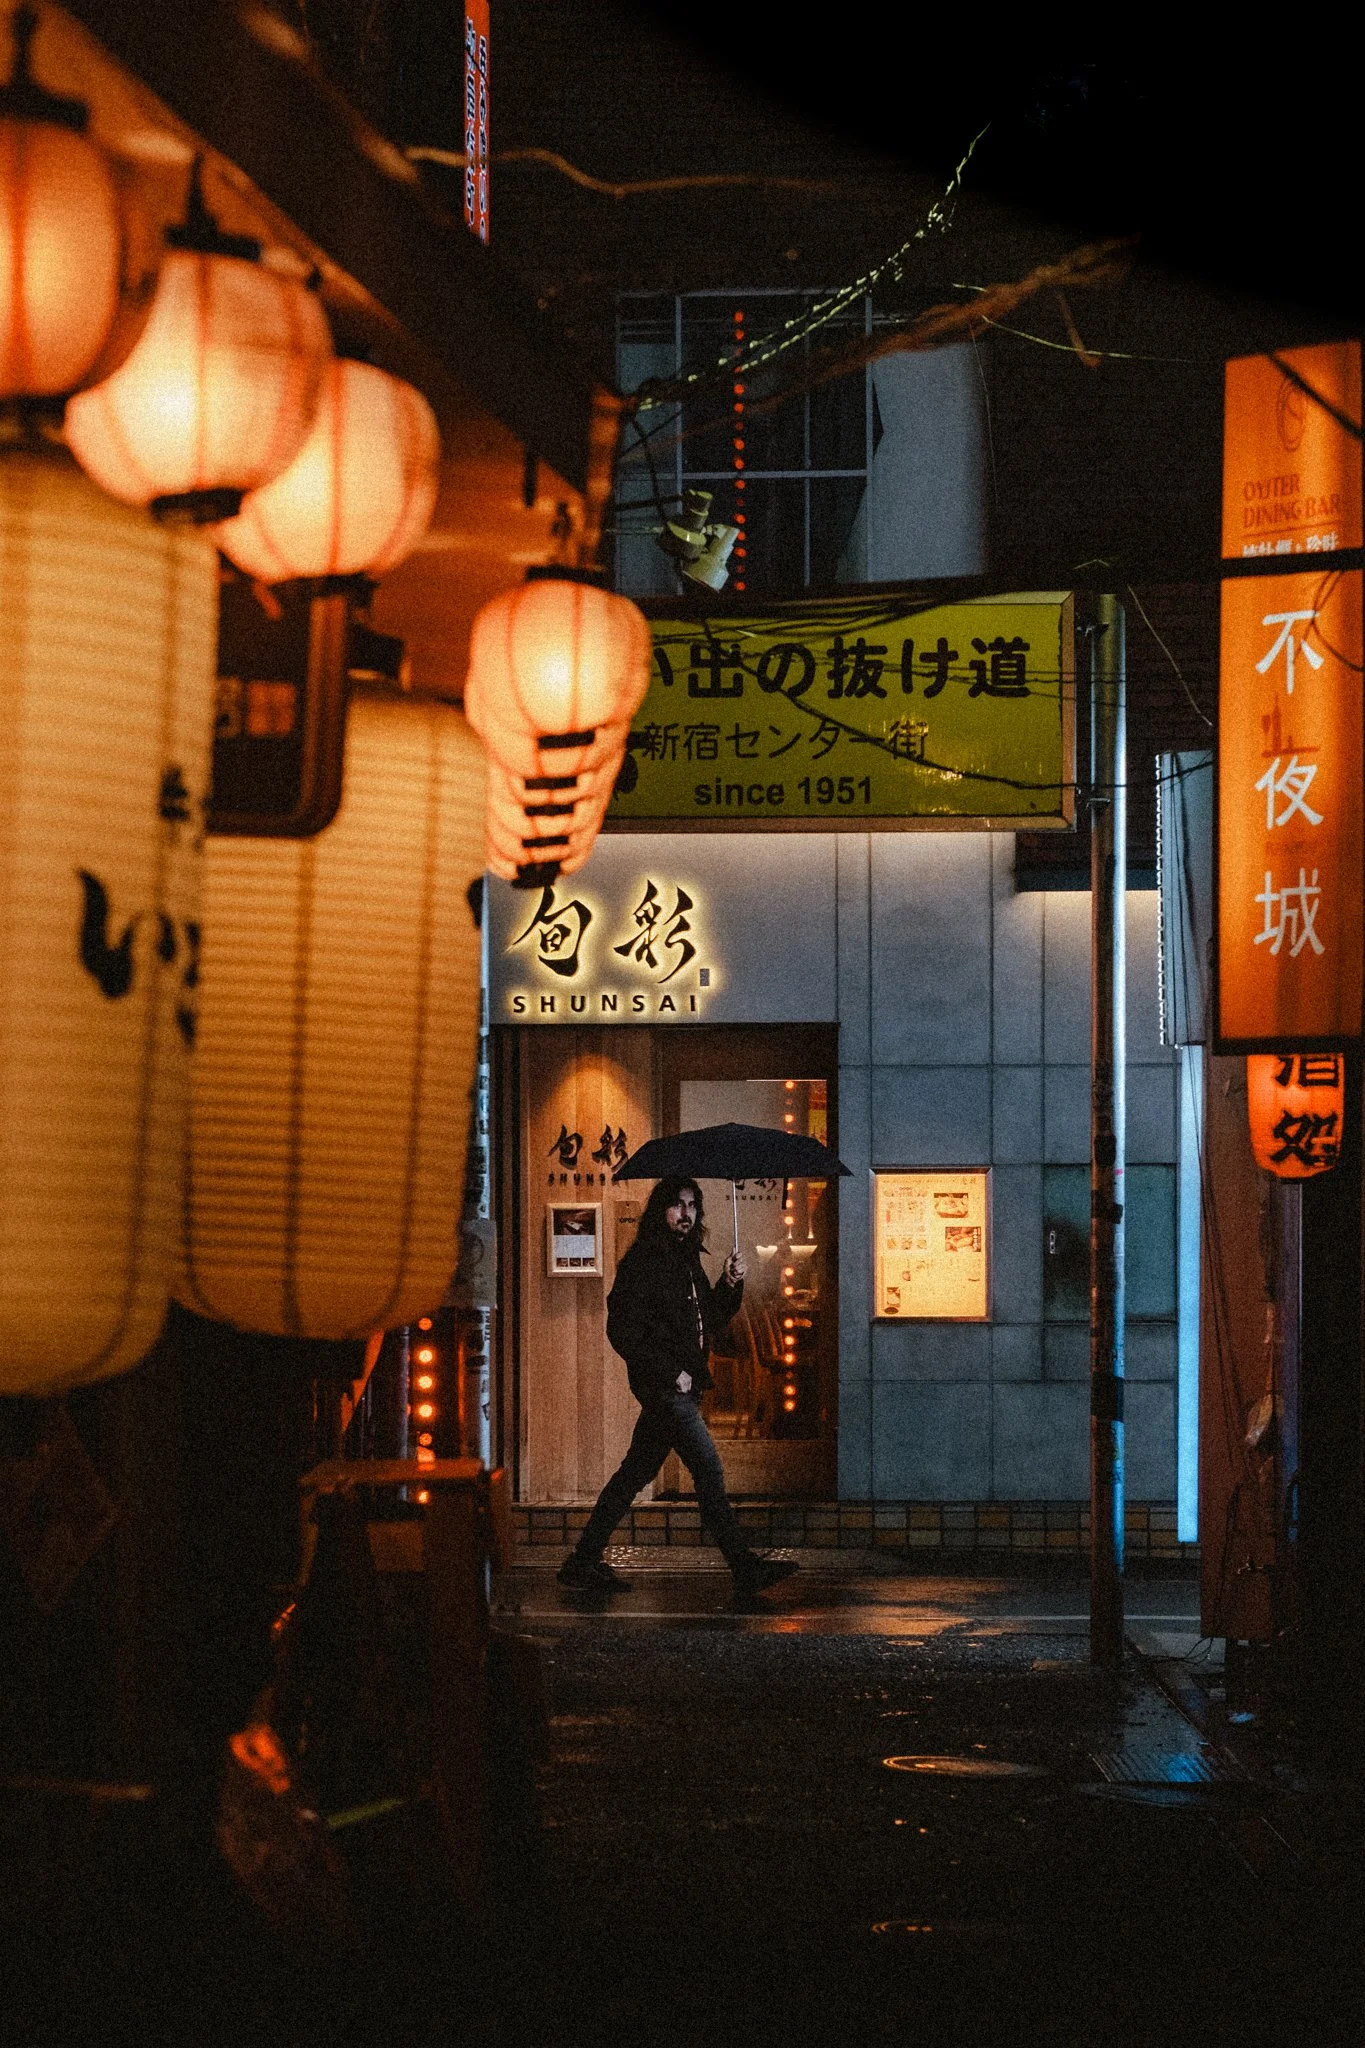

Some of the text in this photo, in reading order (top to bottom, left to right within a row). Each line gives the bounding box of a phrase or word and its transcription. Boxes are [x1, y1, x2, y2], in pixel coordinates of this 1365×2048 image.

[1305, 493, 1341, 518] BAR
[643, 721, 929, 761] 新宿センター街
[694, 777, 872, 806] since 1951
[1255, 609, 1325, 958] 不夜城
[513, 994, 696, 1013] SHUNSAI
